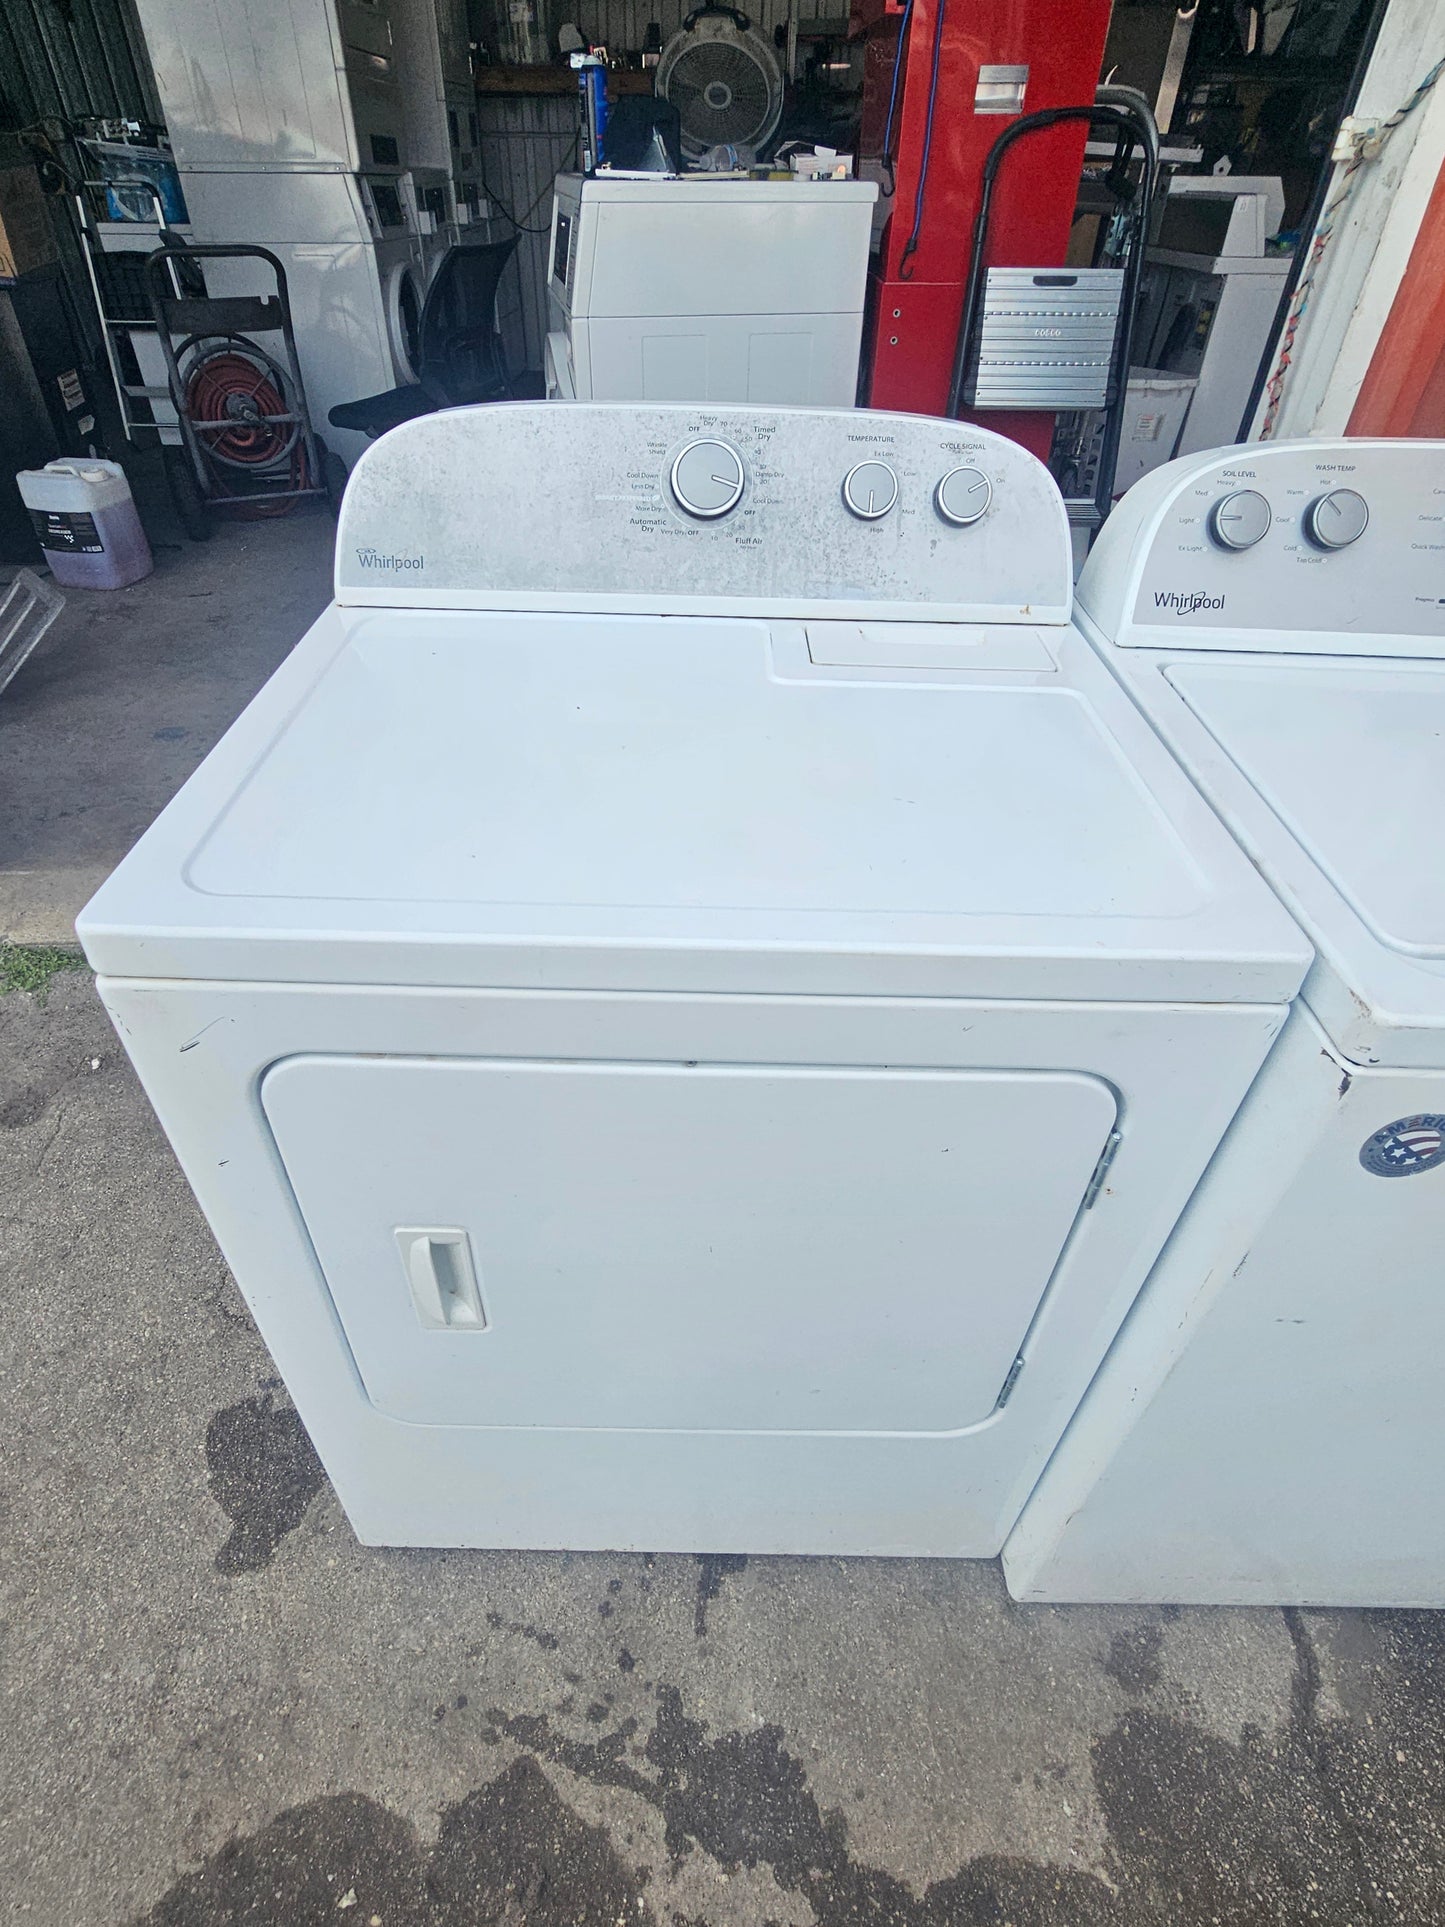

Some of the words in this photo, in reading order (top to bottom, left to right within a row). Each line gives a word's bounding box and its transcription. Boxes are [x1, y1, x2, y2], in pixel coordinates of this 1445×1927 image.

[758, 433, 771, 441] Dry
[847, 435, 895, 443] TEMPERATURE
[940, 442, 960, 450] CYCLE
[641, 525, 654, 533] Dry
[358, 554, 424, 573] Whirlpool
[1154, 591, 1225, 616] Whirlpool
